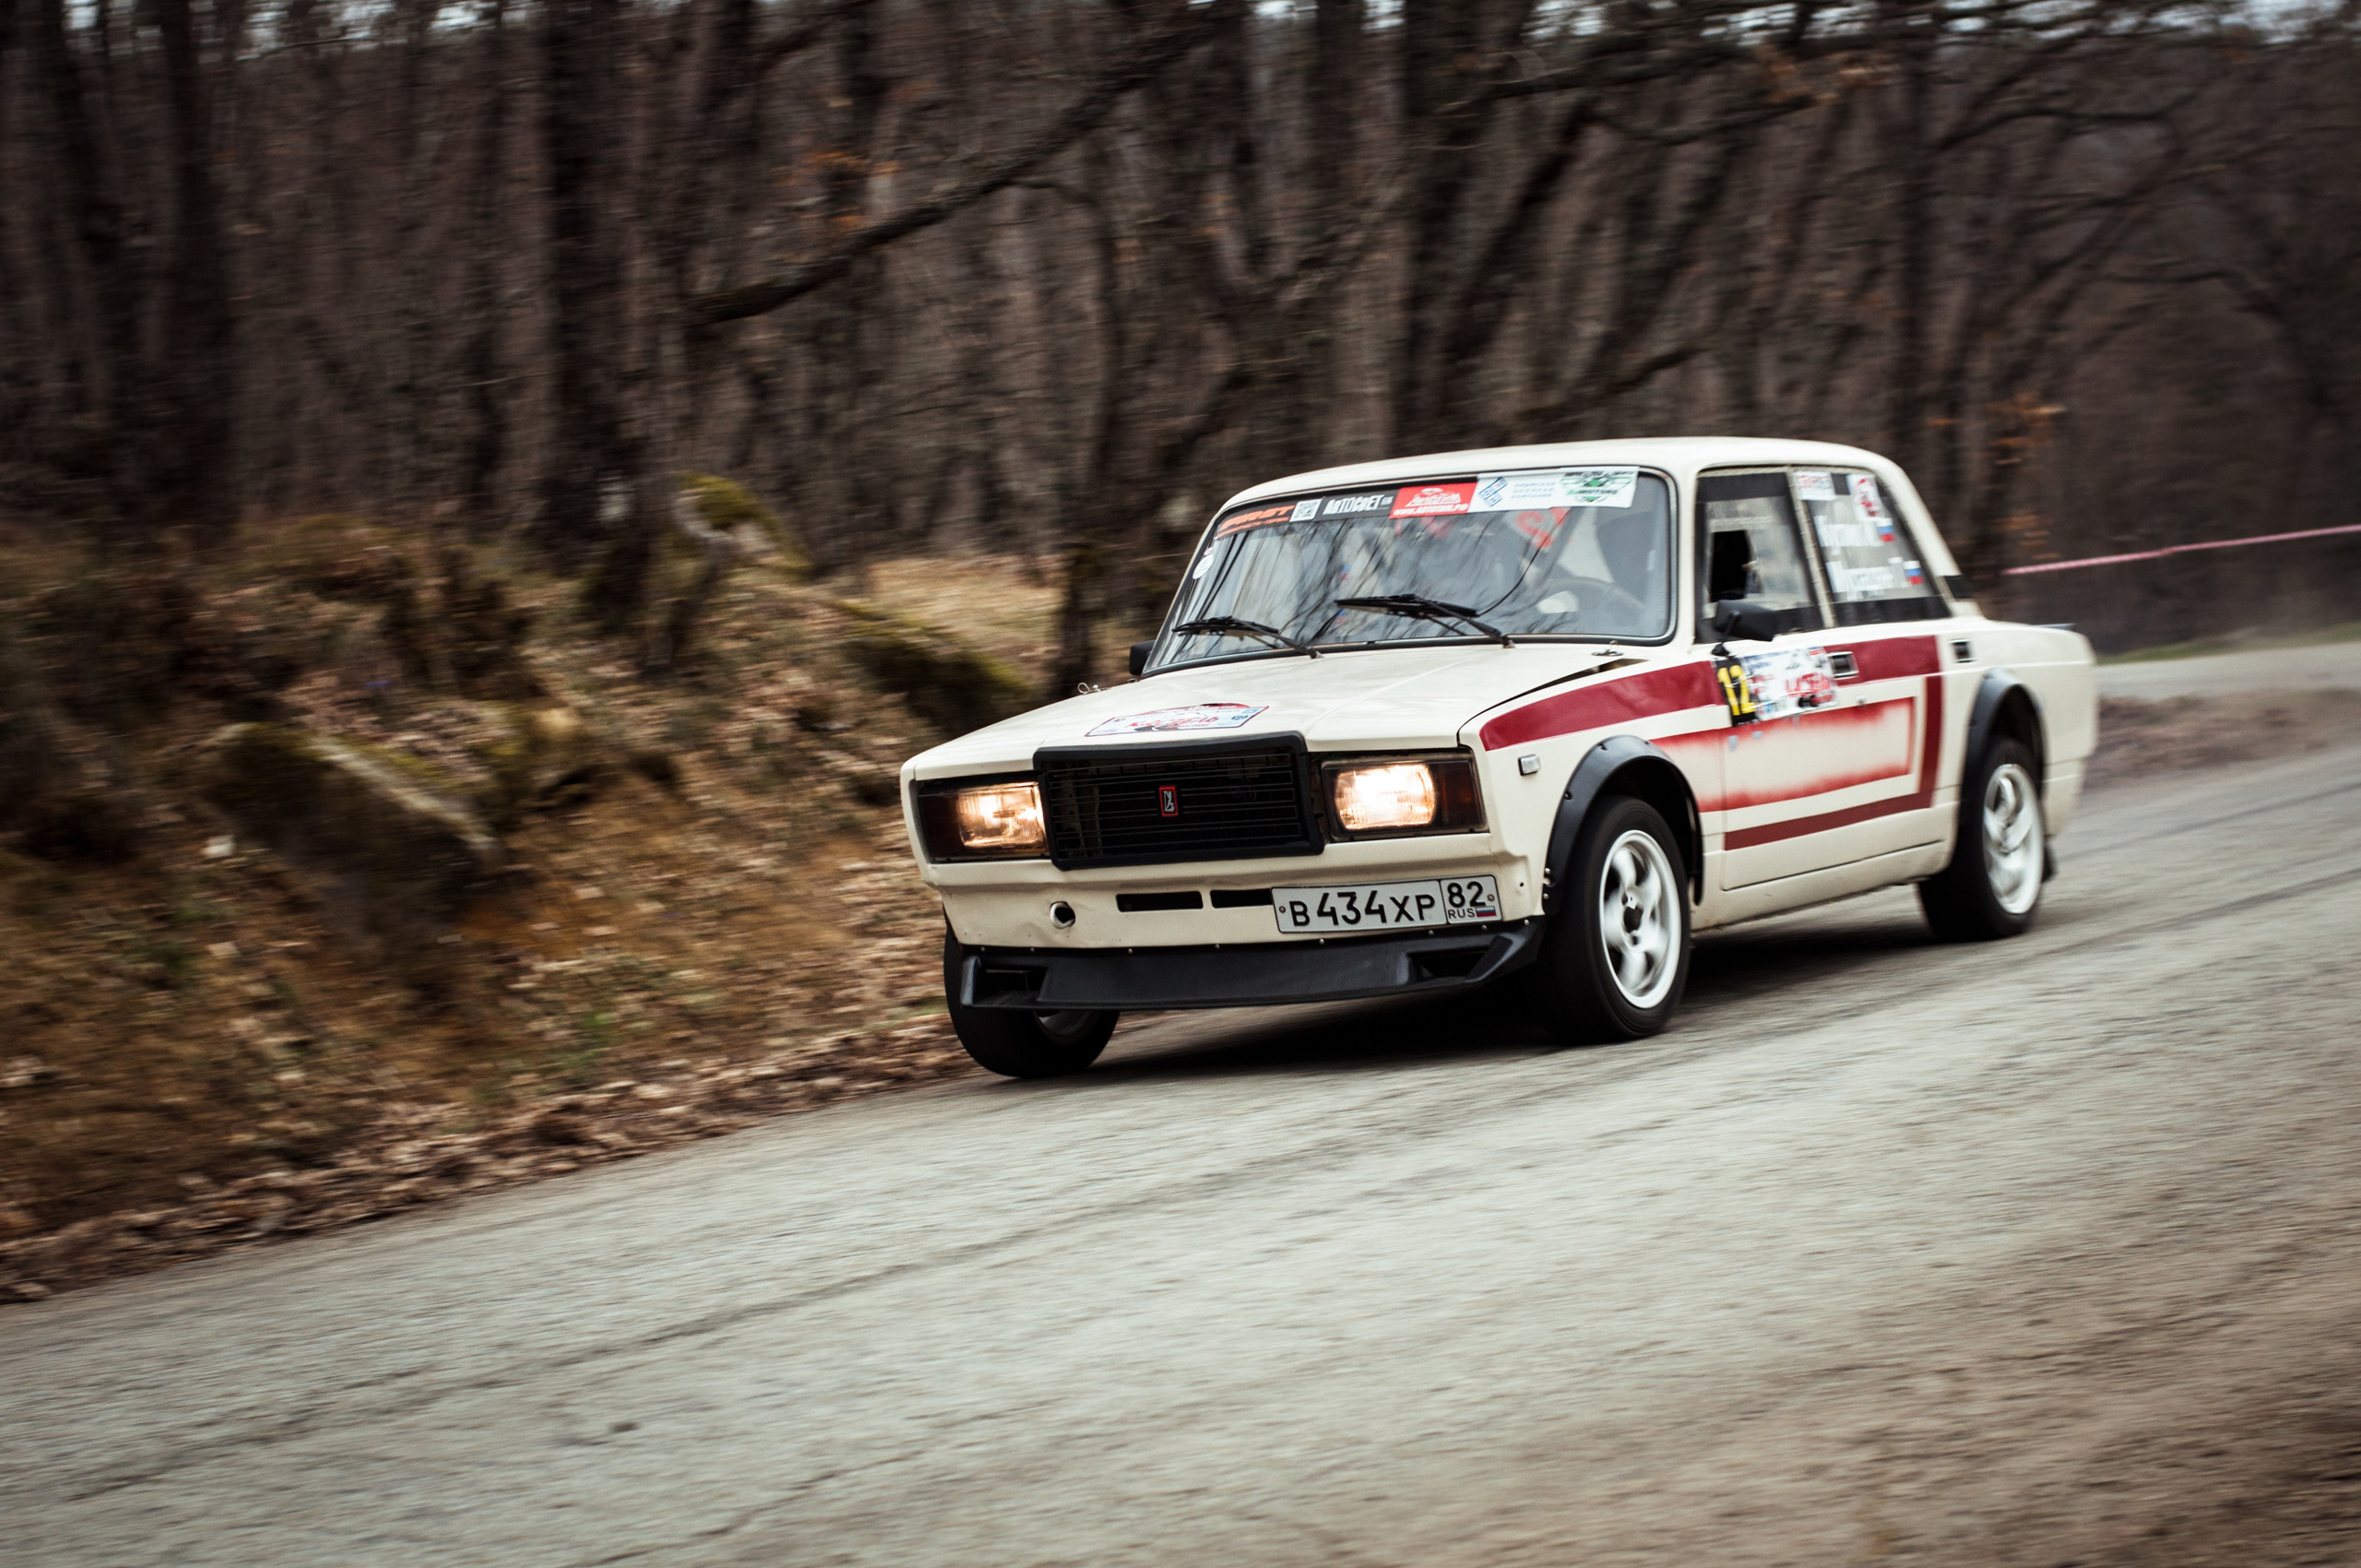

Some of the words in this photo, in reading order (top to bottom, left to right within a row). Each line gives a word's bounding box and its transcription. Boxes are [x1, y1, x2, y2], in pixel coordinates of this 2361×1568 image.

[1288, 889, 1436, 927] В434ХР
[1447, 881, 1487, 909] 82
[1447, 908, 1476, 920] RUS
